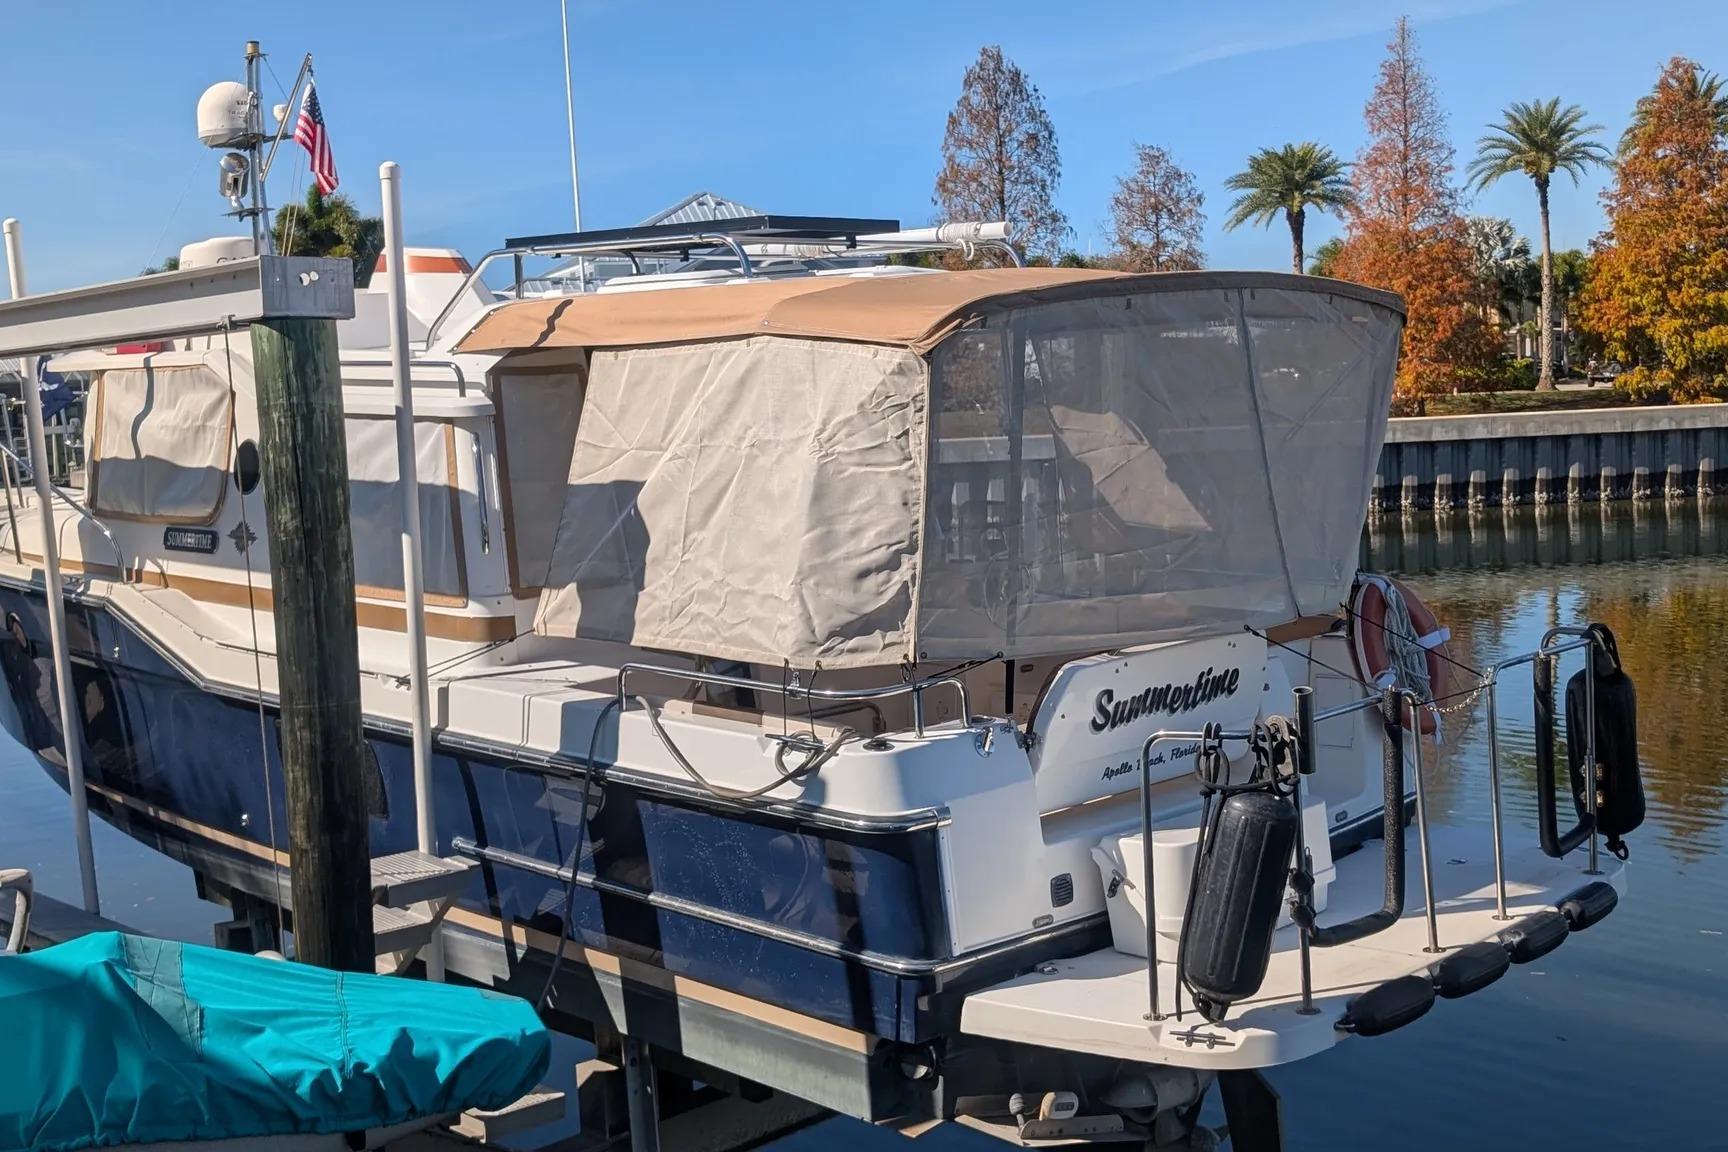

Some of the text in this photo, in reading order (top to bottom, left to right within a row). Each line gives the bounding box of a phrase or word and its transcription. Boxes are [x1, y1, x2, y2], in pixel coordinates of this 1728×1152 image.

[167, 531, 212, 549] SUMMERTIME
[1089, 666, 1240, 734] Summertime
[1101, 761, 1133, 780] Apollo
